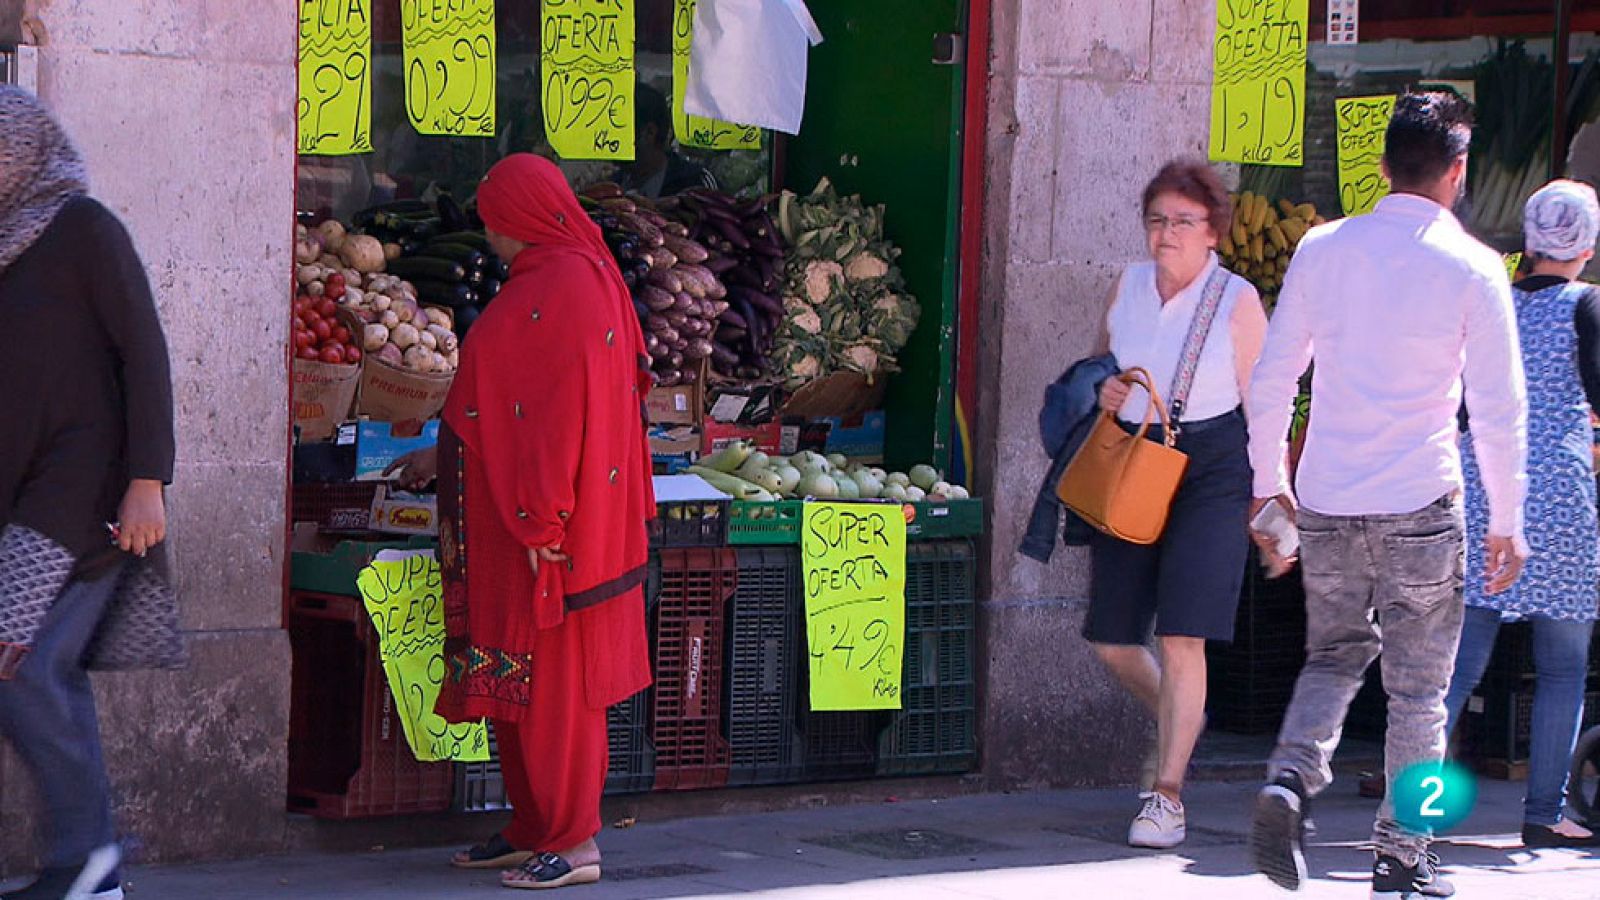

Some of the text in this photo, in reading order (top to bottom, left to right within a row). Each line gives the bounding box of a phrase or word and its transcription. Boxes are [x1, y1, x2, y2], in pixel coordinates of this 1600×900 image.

[544, 12, 621, 54] OFERTA
[1216, 21, 1301, 64] OFERTA
[1341, 101, 1389, 132] SUPER
[1341, 129, 1387, 149] OFERT
[370, 375, 429, 401] PREMIUM
[806, 506, 889, 559] SUPER
[363, 554, 441, 605] SUPE
[809, 555, 889, 598] OFERTA
